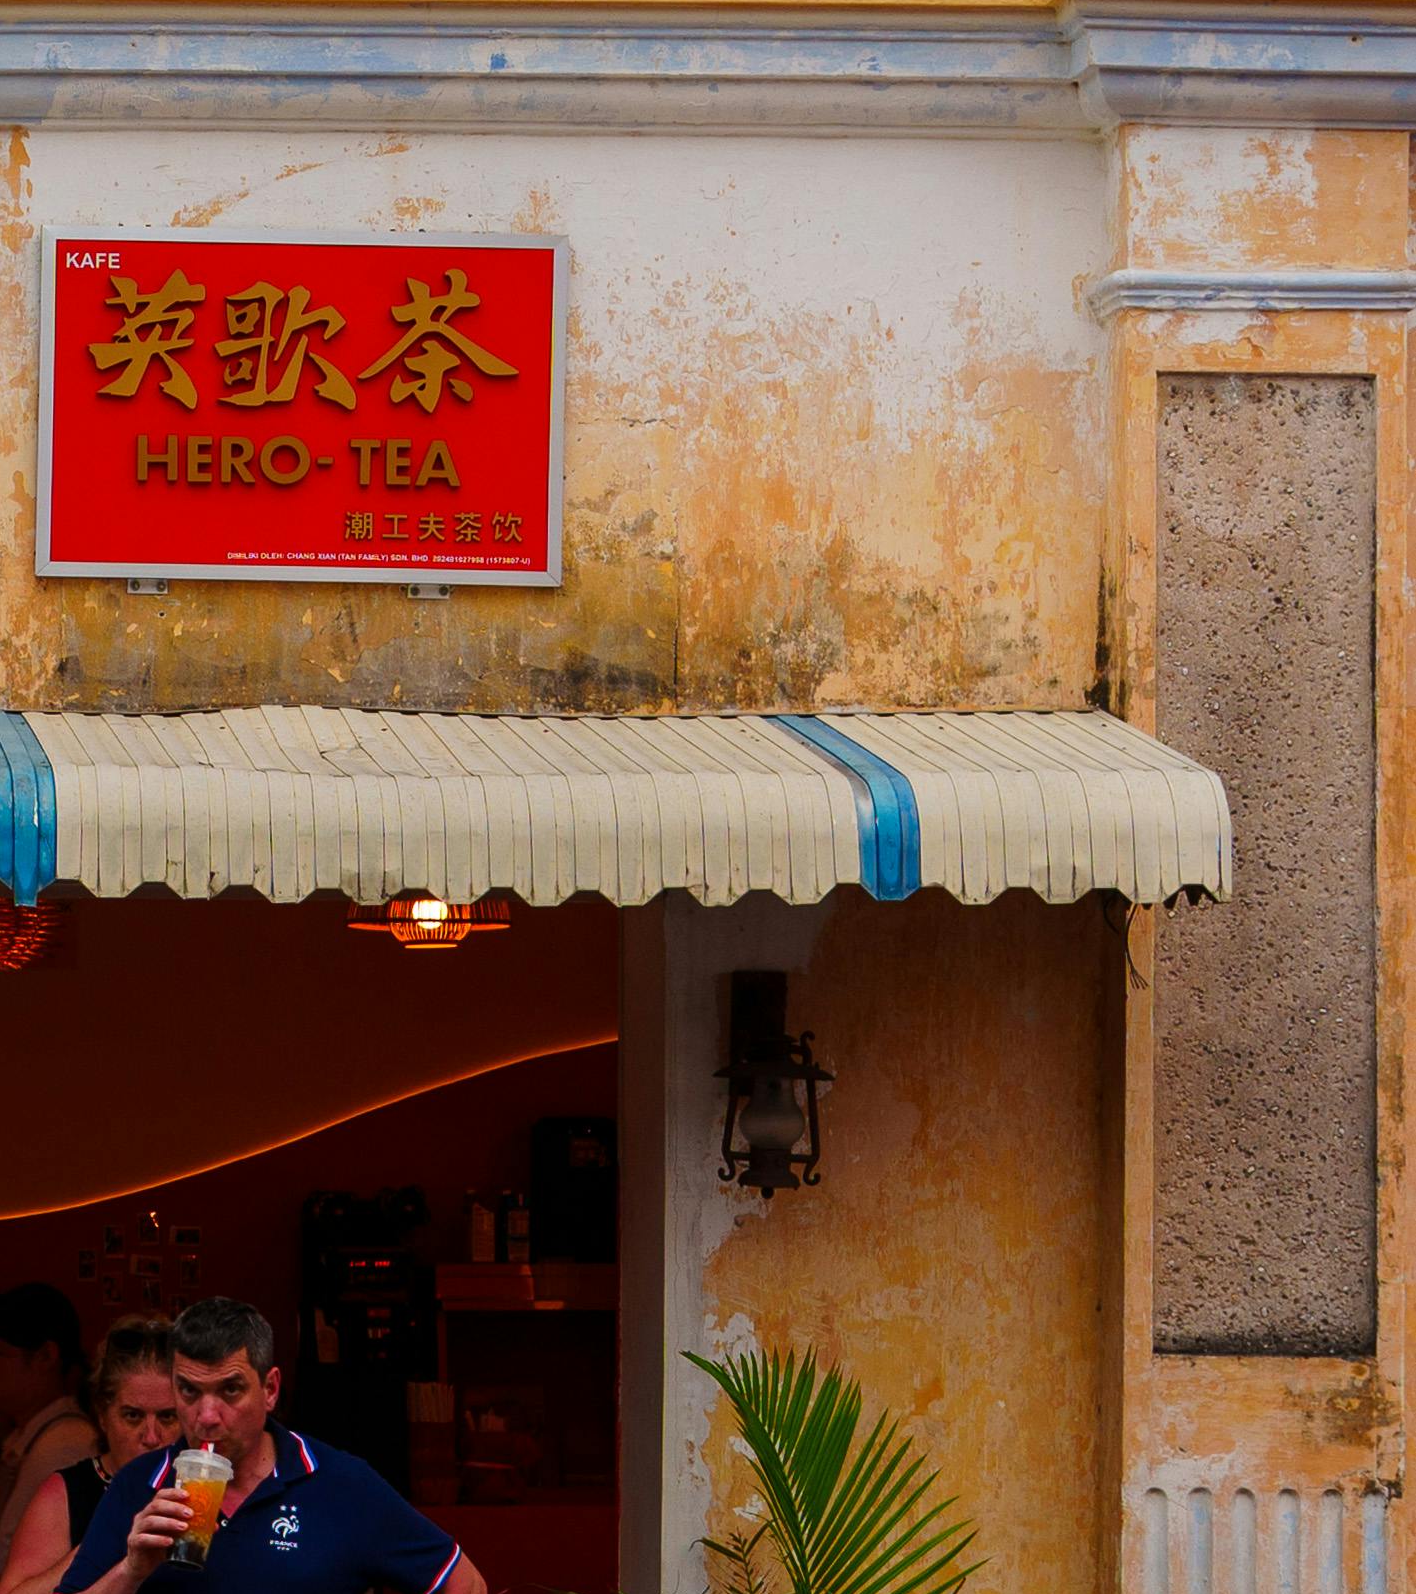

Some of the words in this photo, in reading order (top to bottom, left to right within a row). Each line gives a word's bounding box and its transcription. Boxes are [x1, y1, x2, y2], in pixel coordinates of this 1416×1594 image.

[65, 251, 121, 270] KAFE
[88, 268, 519, 414] 英歌茶
[344, 511, 524, 544] 潮工夫茶饮
[286, 552, 315, 561] CHANG
[317, 552, 336, 561] XIAN
[338, 552, 357, 562] (TAN
[358, 553, 389, 563] FAMILY)
